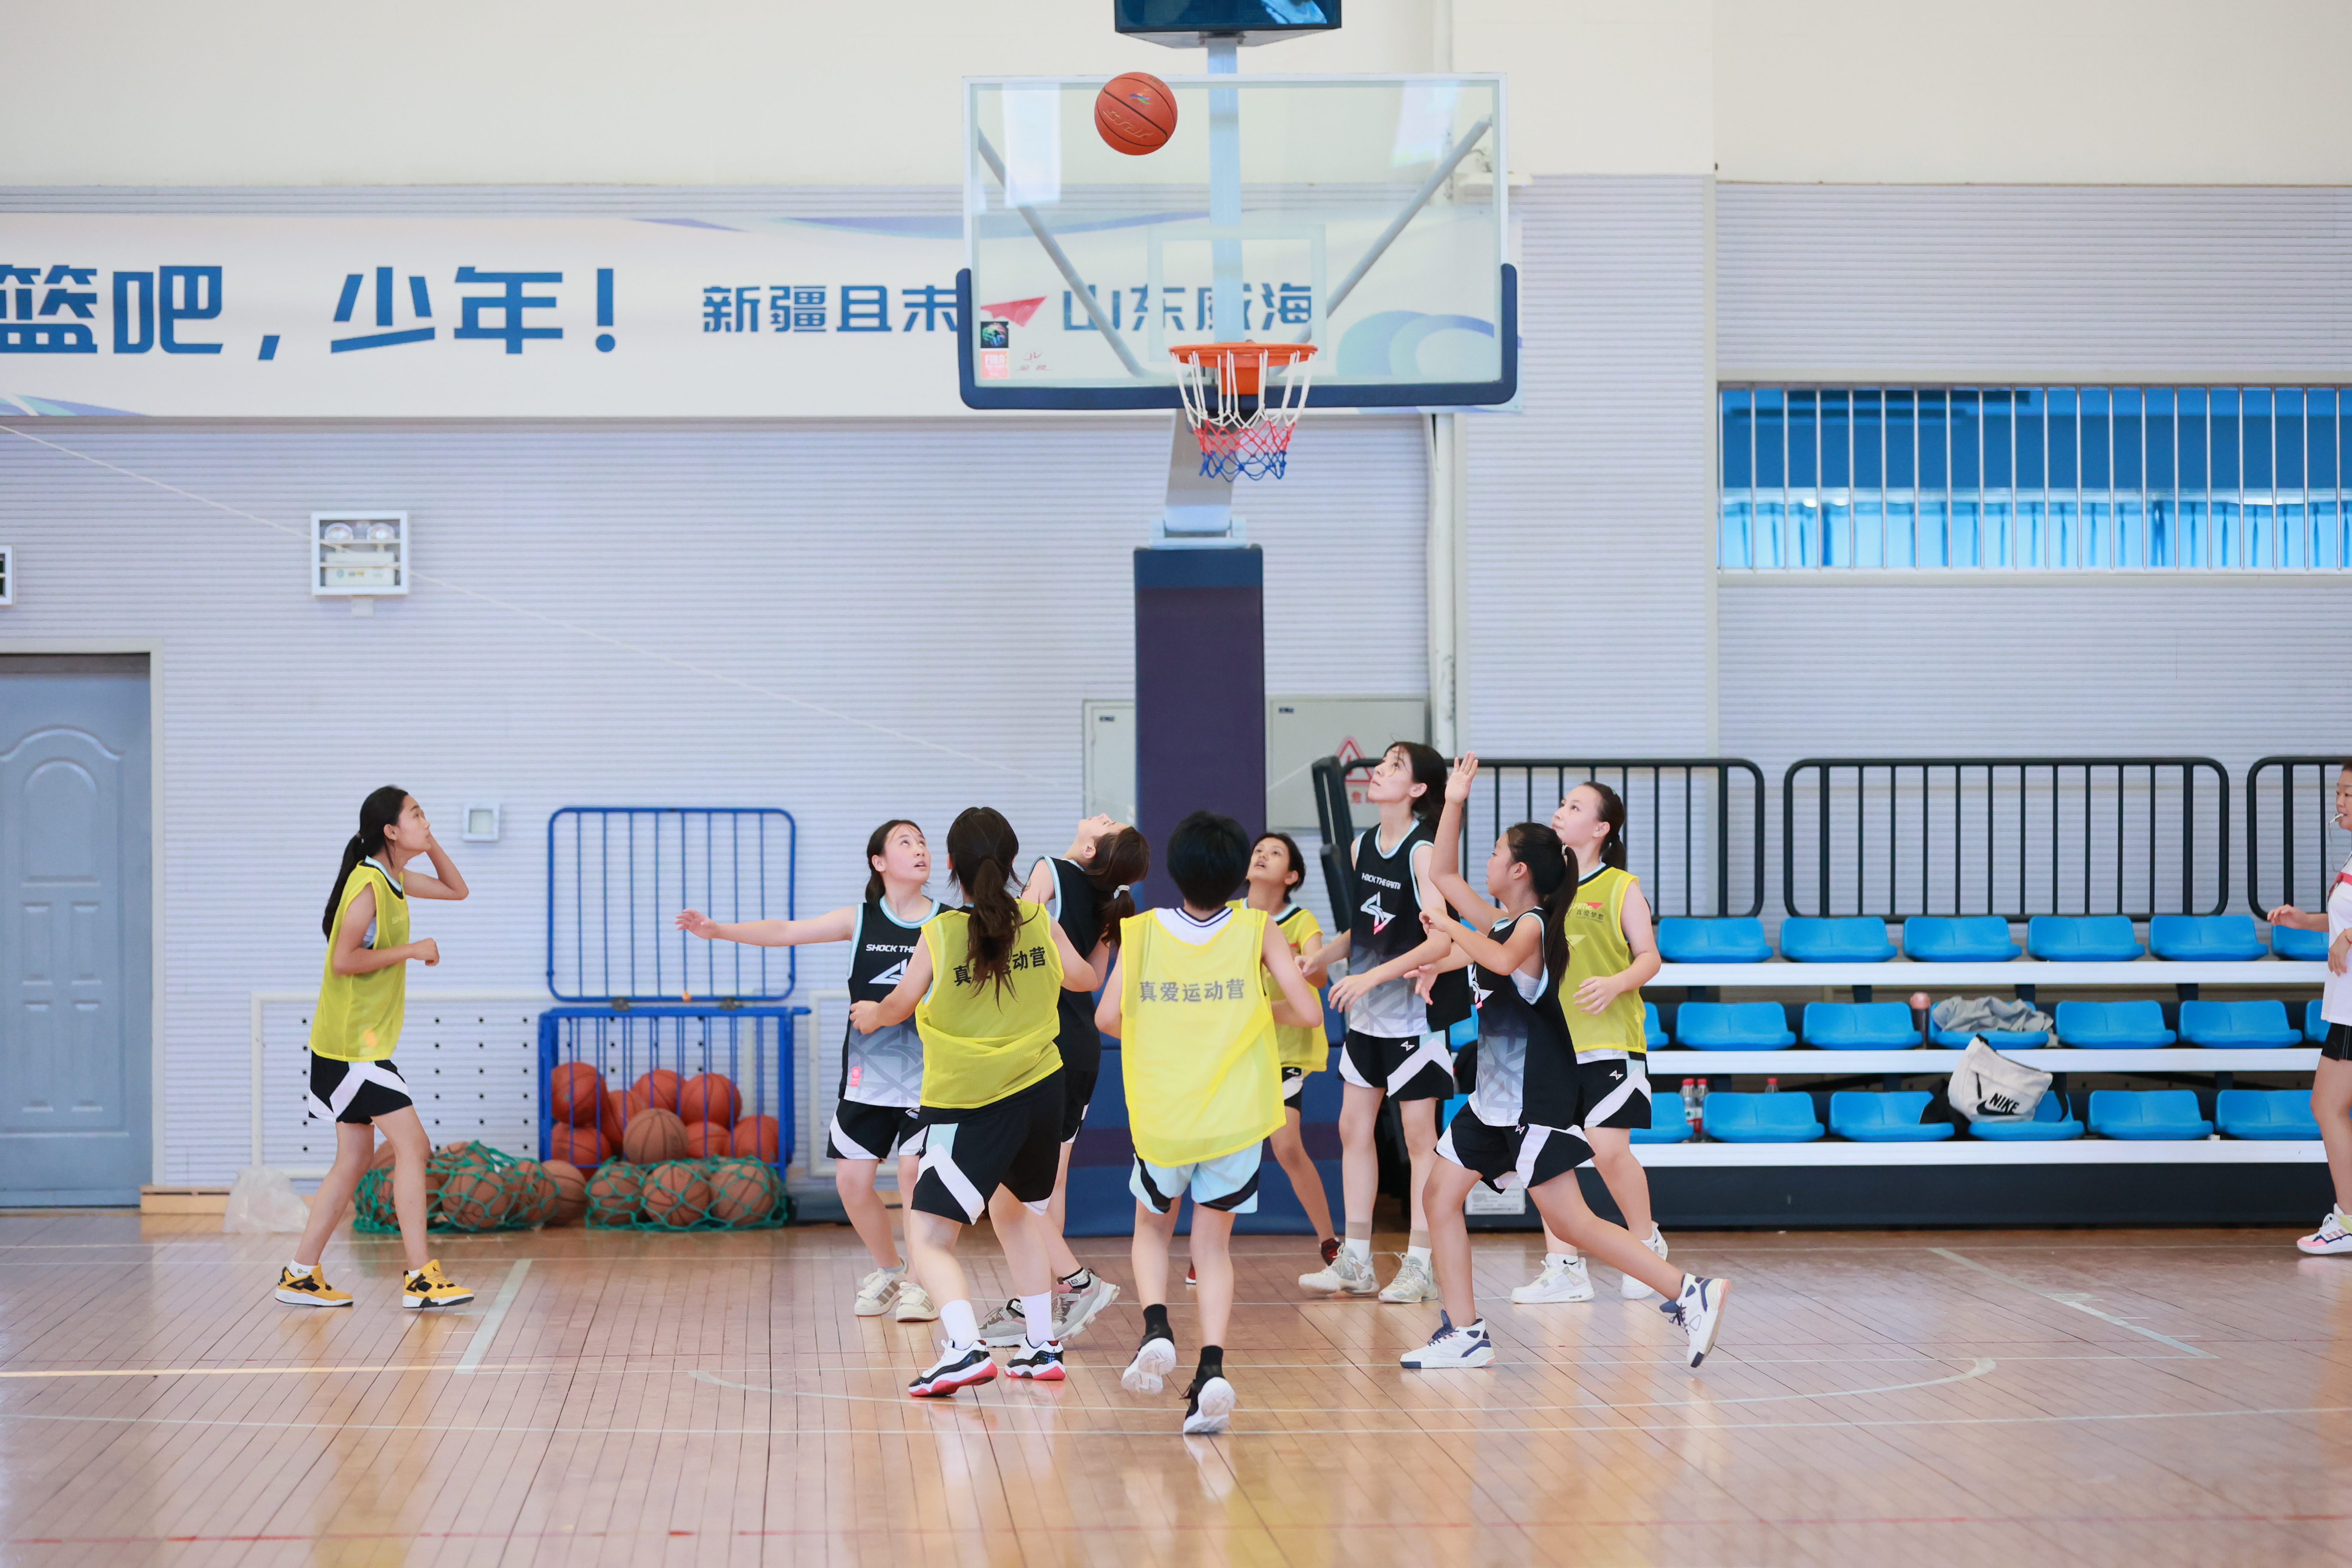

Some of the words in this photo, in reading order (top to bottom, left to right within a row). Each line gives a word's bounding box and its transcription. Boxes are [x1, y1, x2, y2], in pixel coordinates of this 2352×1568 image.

[703, 285, 957, 332] 新疆且末
[1361, 873, 1376, 884] HOCK
[1376, 876, 1387, 886] THE
[866, 944, 898, 952] SHOCK
[899, 945, 916, 953] THE
[953, 946, 1045, 986] 真动营
[1139, 979, 1244, 1002] 真爱运动营
[1989, 1092, 2020, 1115] NIKE
